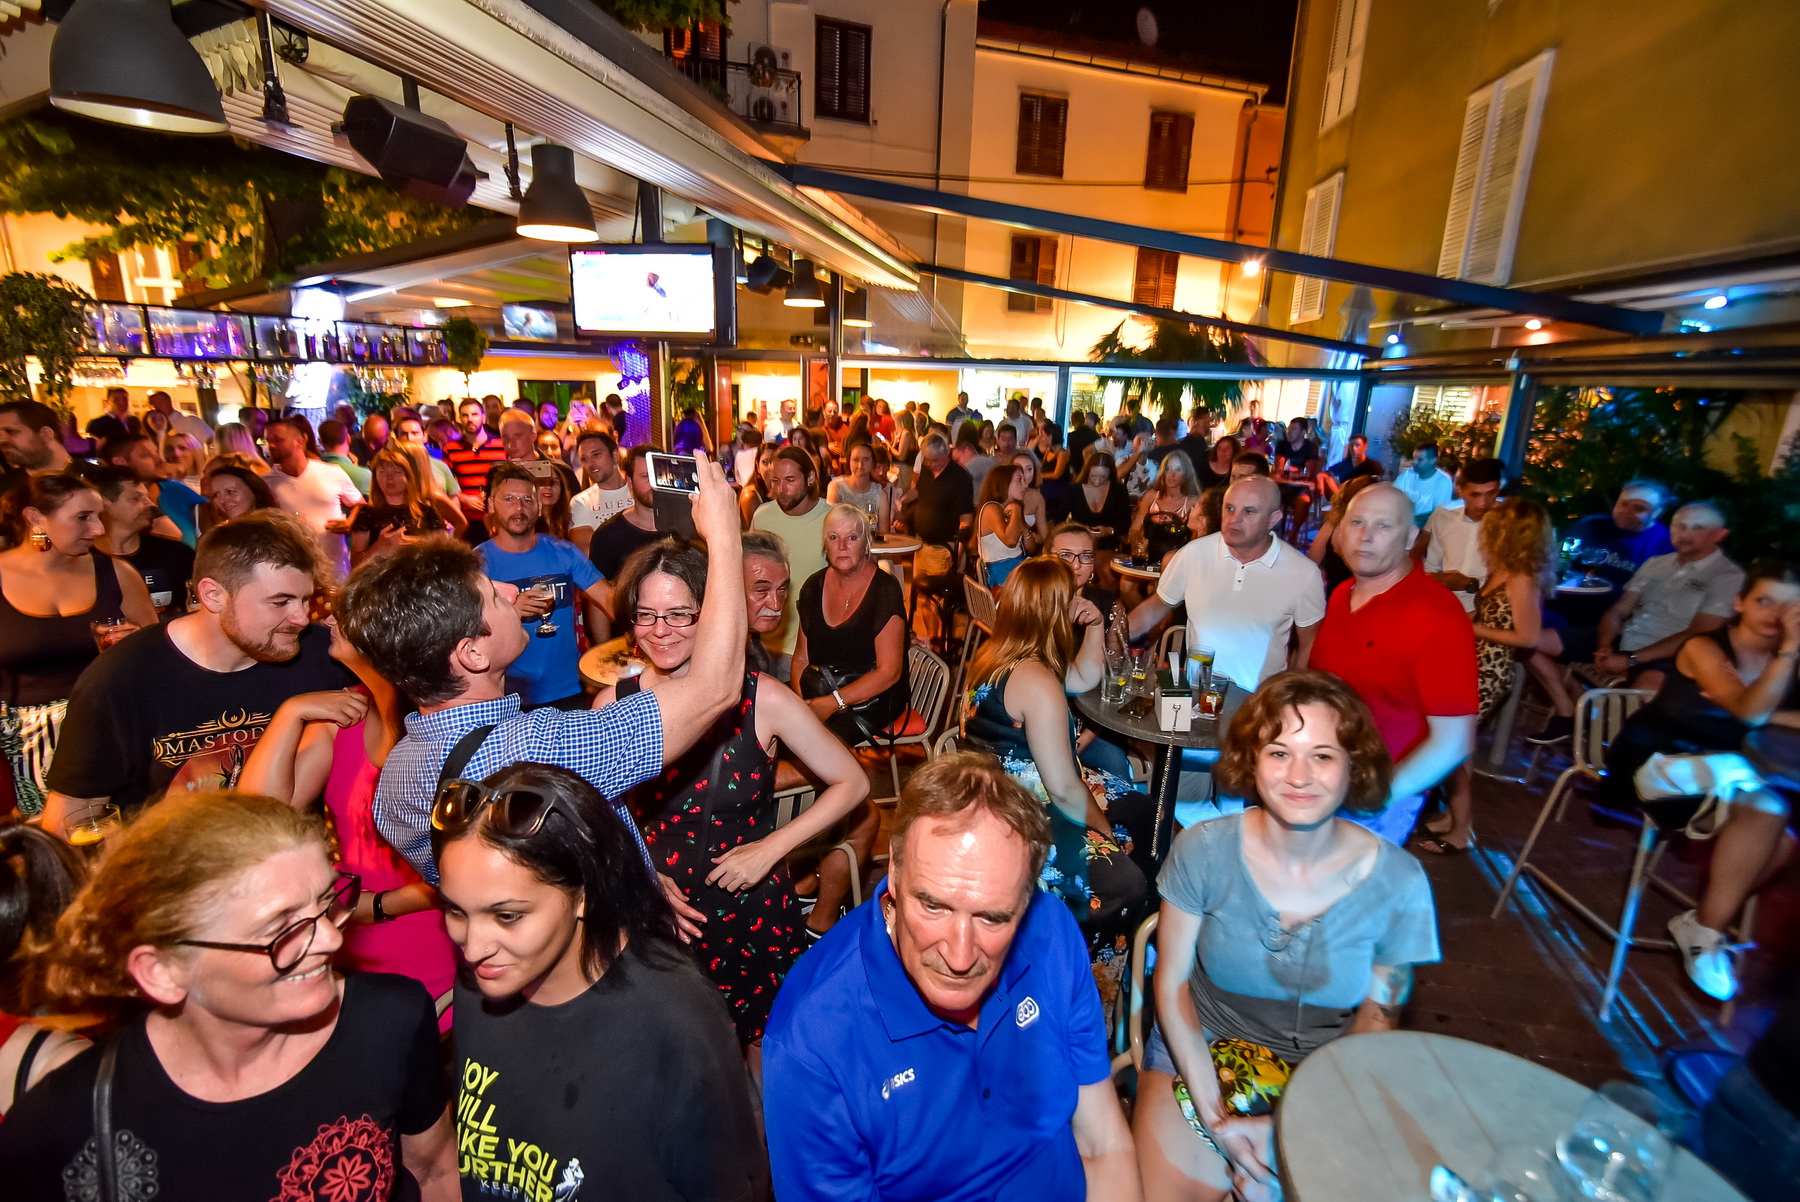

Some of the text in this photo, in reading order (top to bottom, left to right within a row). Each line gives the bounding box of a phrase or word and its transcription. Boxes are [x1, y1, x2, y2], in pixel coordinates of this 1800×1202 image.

[592, 497, 634, 512] GUES
[165, 726, 265, 756] MASTOD
[457, 1121, 558, 1183] KE YOU
[458, 1154, 554, 1202] URTHER
[480, 1179, 519, 1196] KEEP
